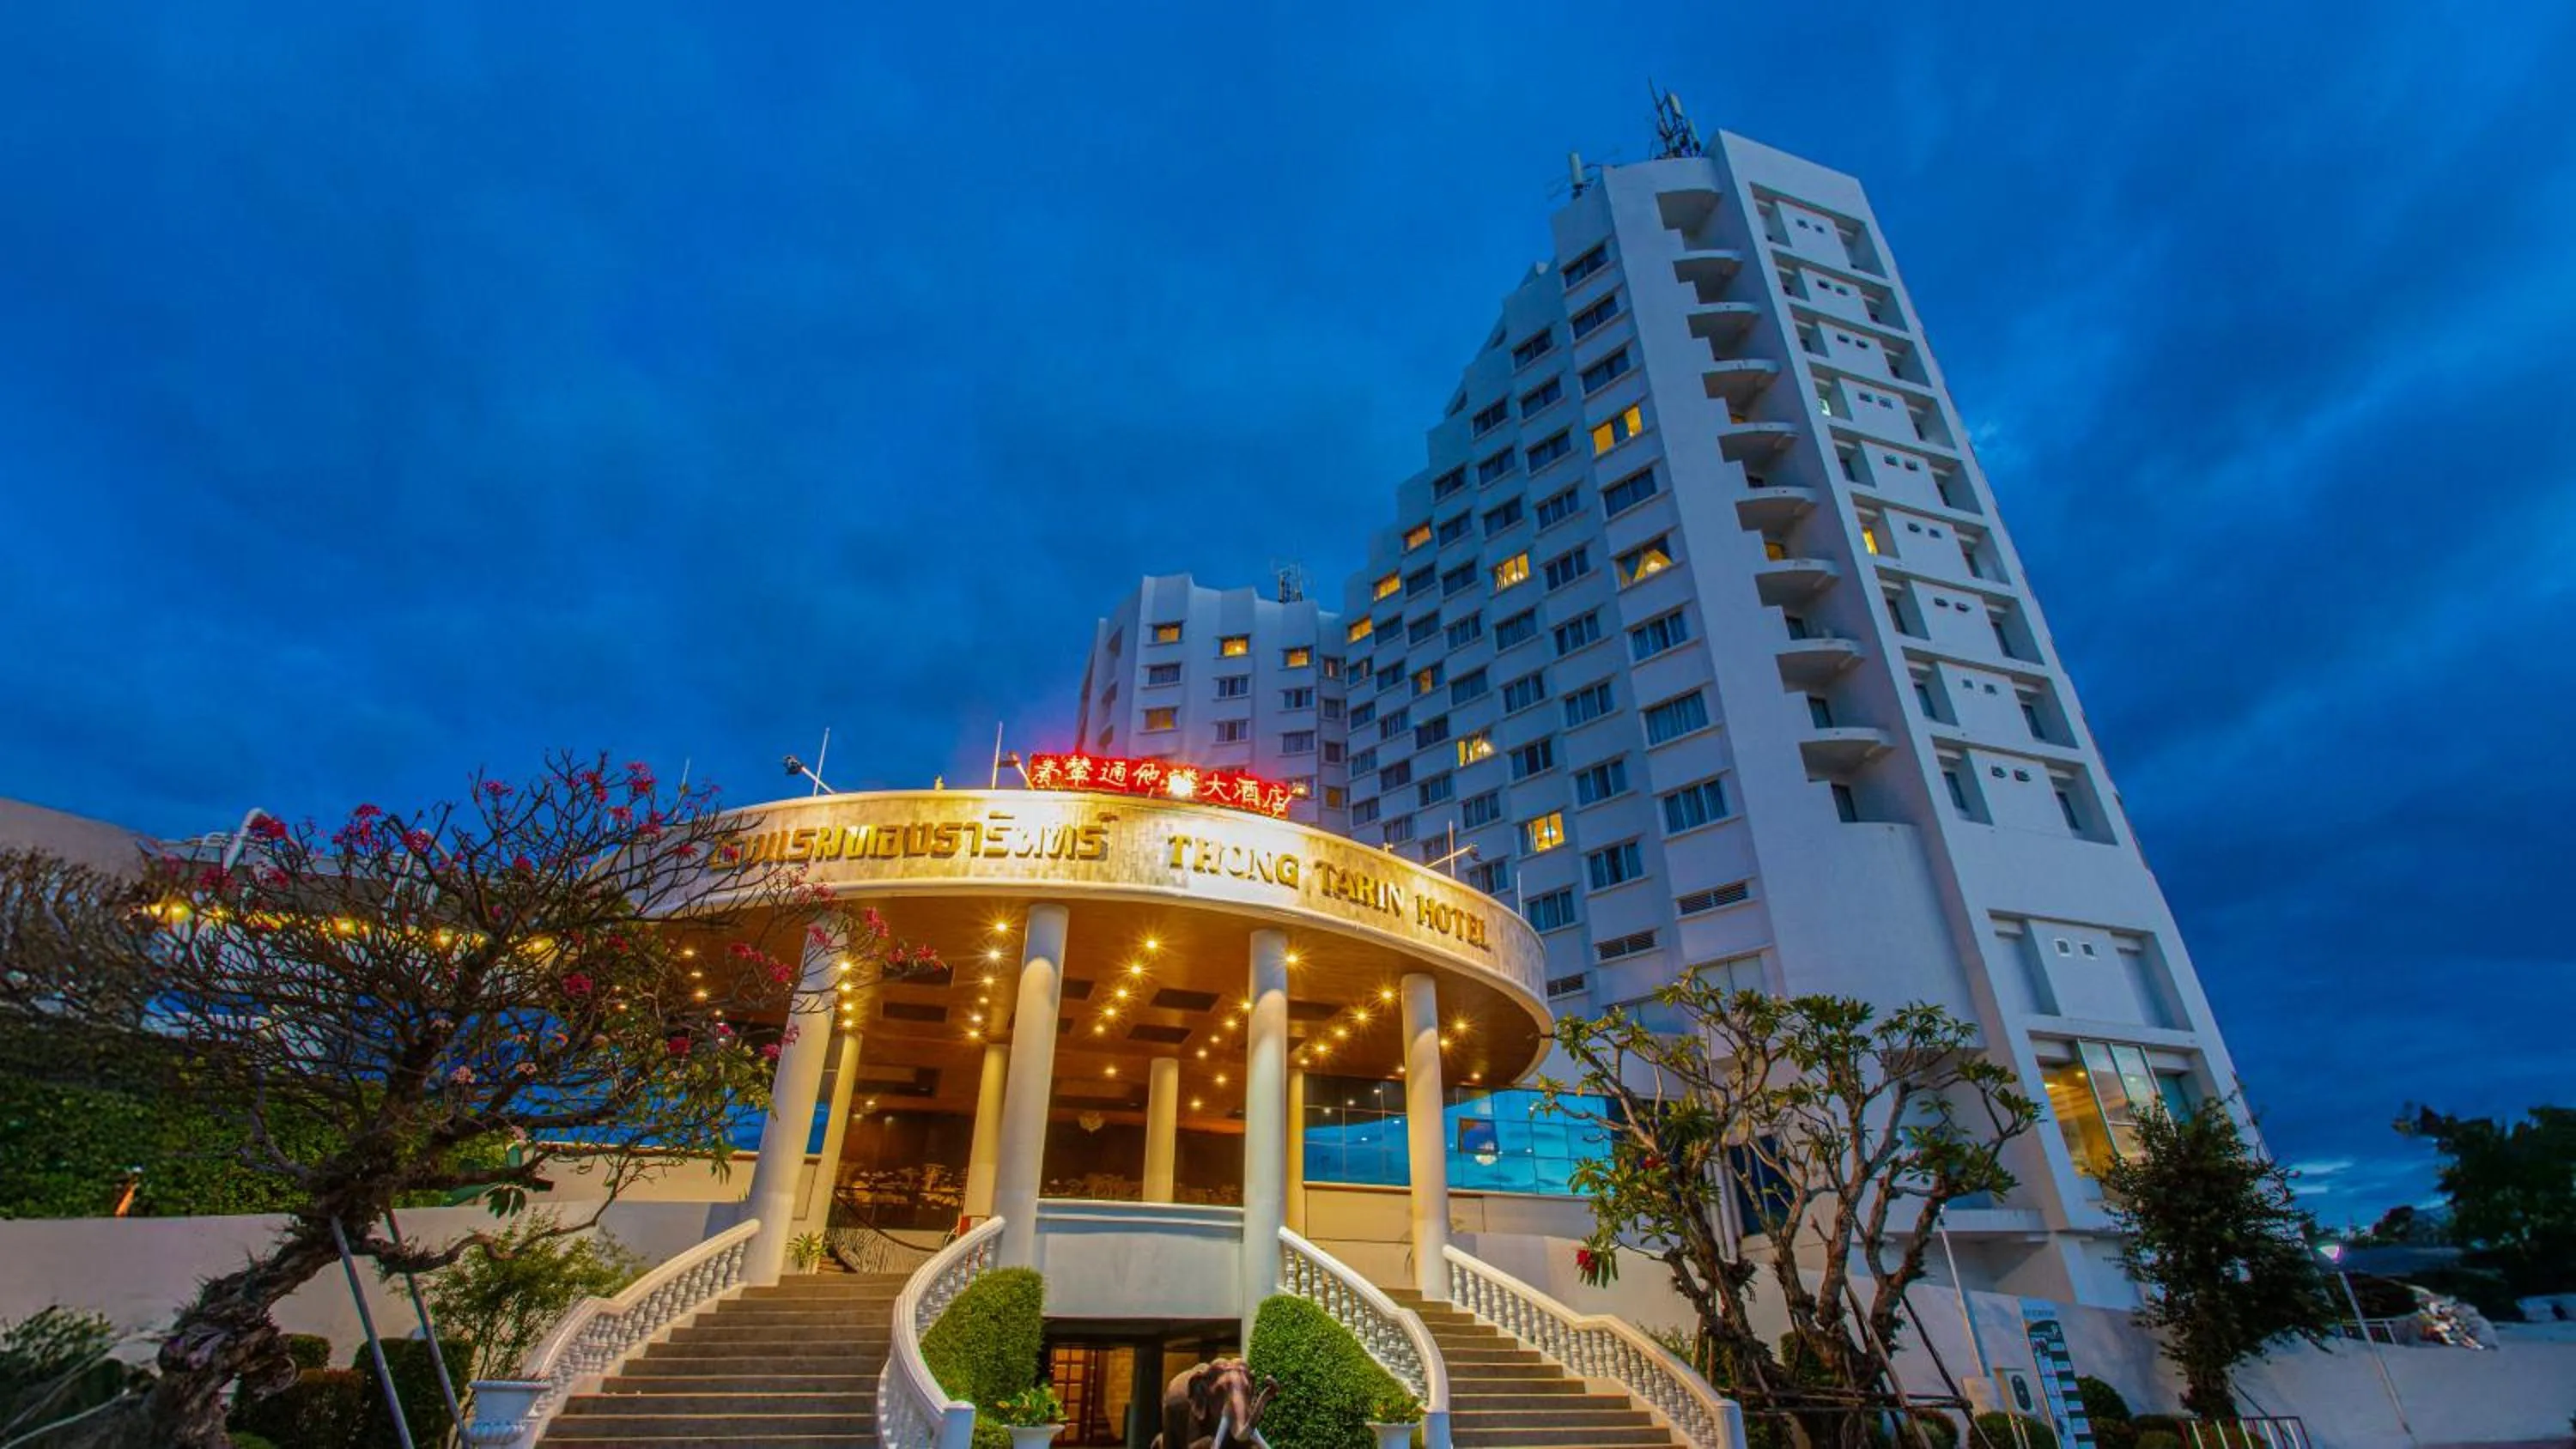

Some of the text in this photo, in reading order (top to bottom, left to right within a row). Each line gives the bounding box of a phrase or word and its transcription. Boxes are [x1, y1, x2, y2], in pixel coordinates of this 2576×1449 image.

[1167, 833, 1491, 953] THONG TARIN HOTEL
